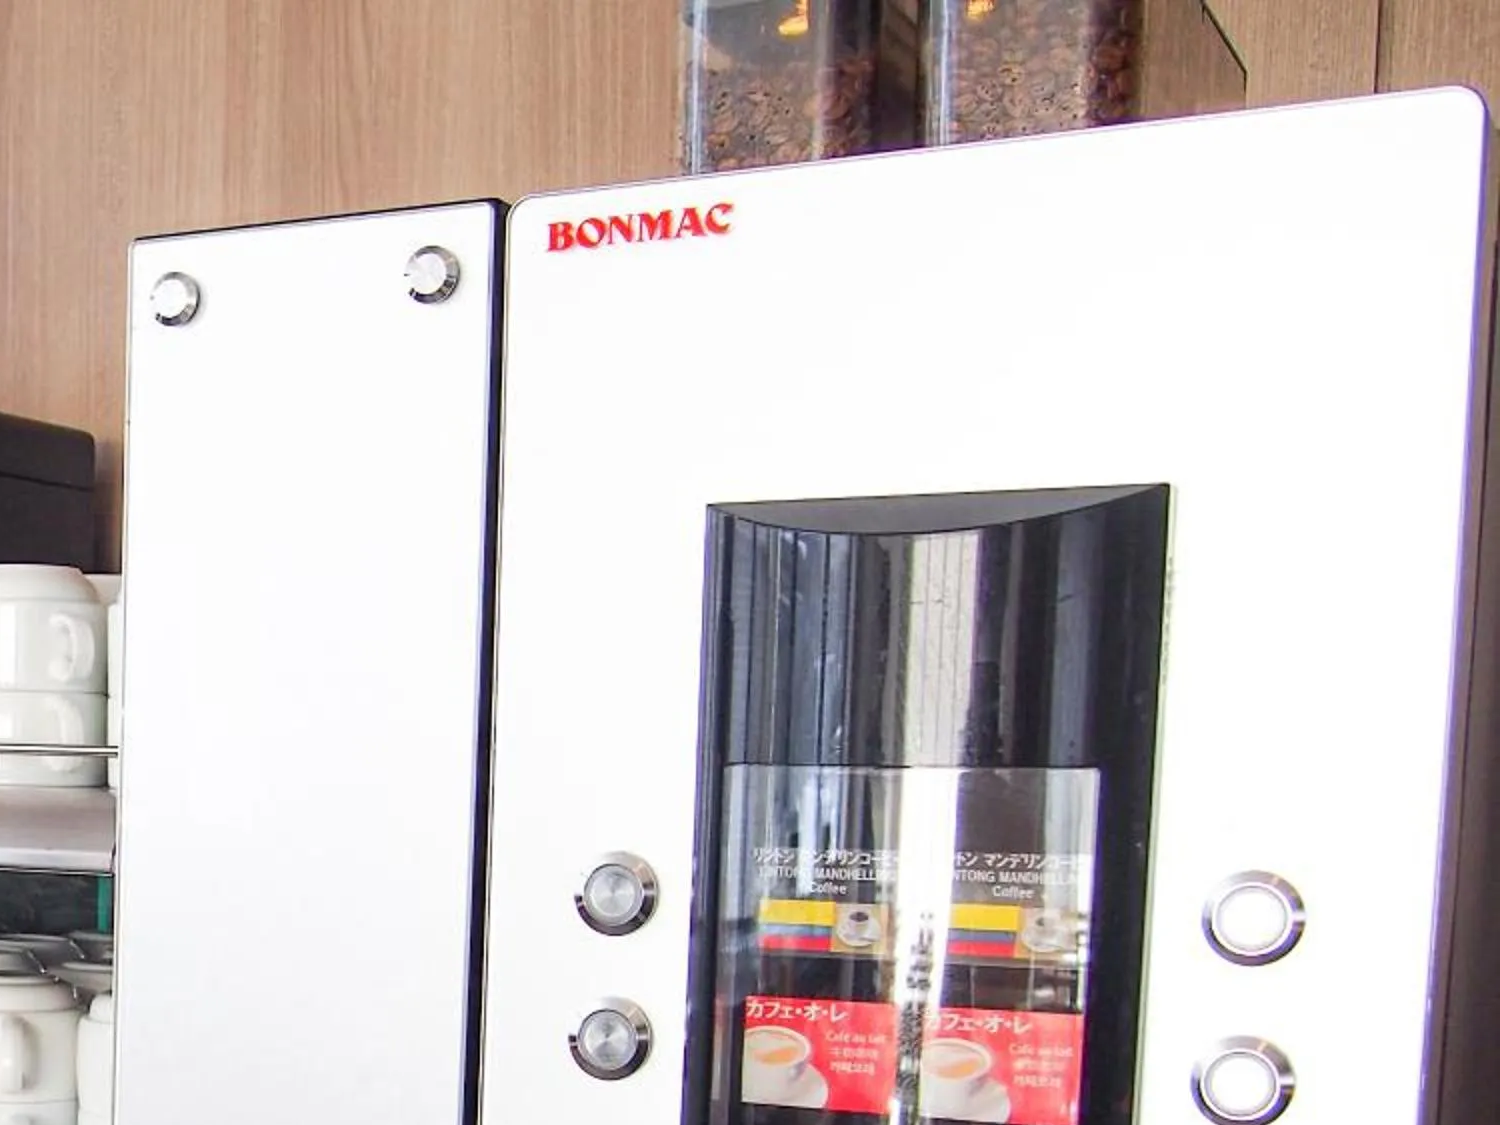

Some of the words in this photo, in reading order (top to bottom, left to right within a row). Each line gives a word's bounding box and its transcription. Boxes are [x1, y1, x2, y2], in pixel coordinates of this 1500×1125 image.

[547, 203, 733, 252] BONMAC
[992, 885, 1035, 899] Coffee
[746, 1000, 848, 1022] カフェ・オ・レ
